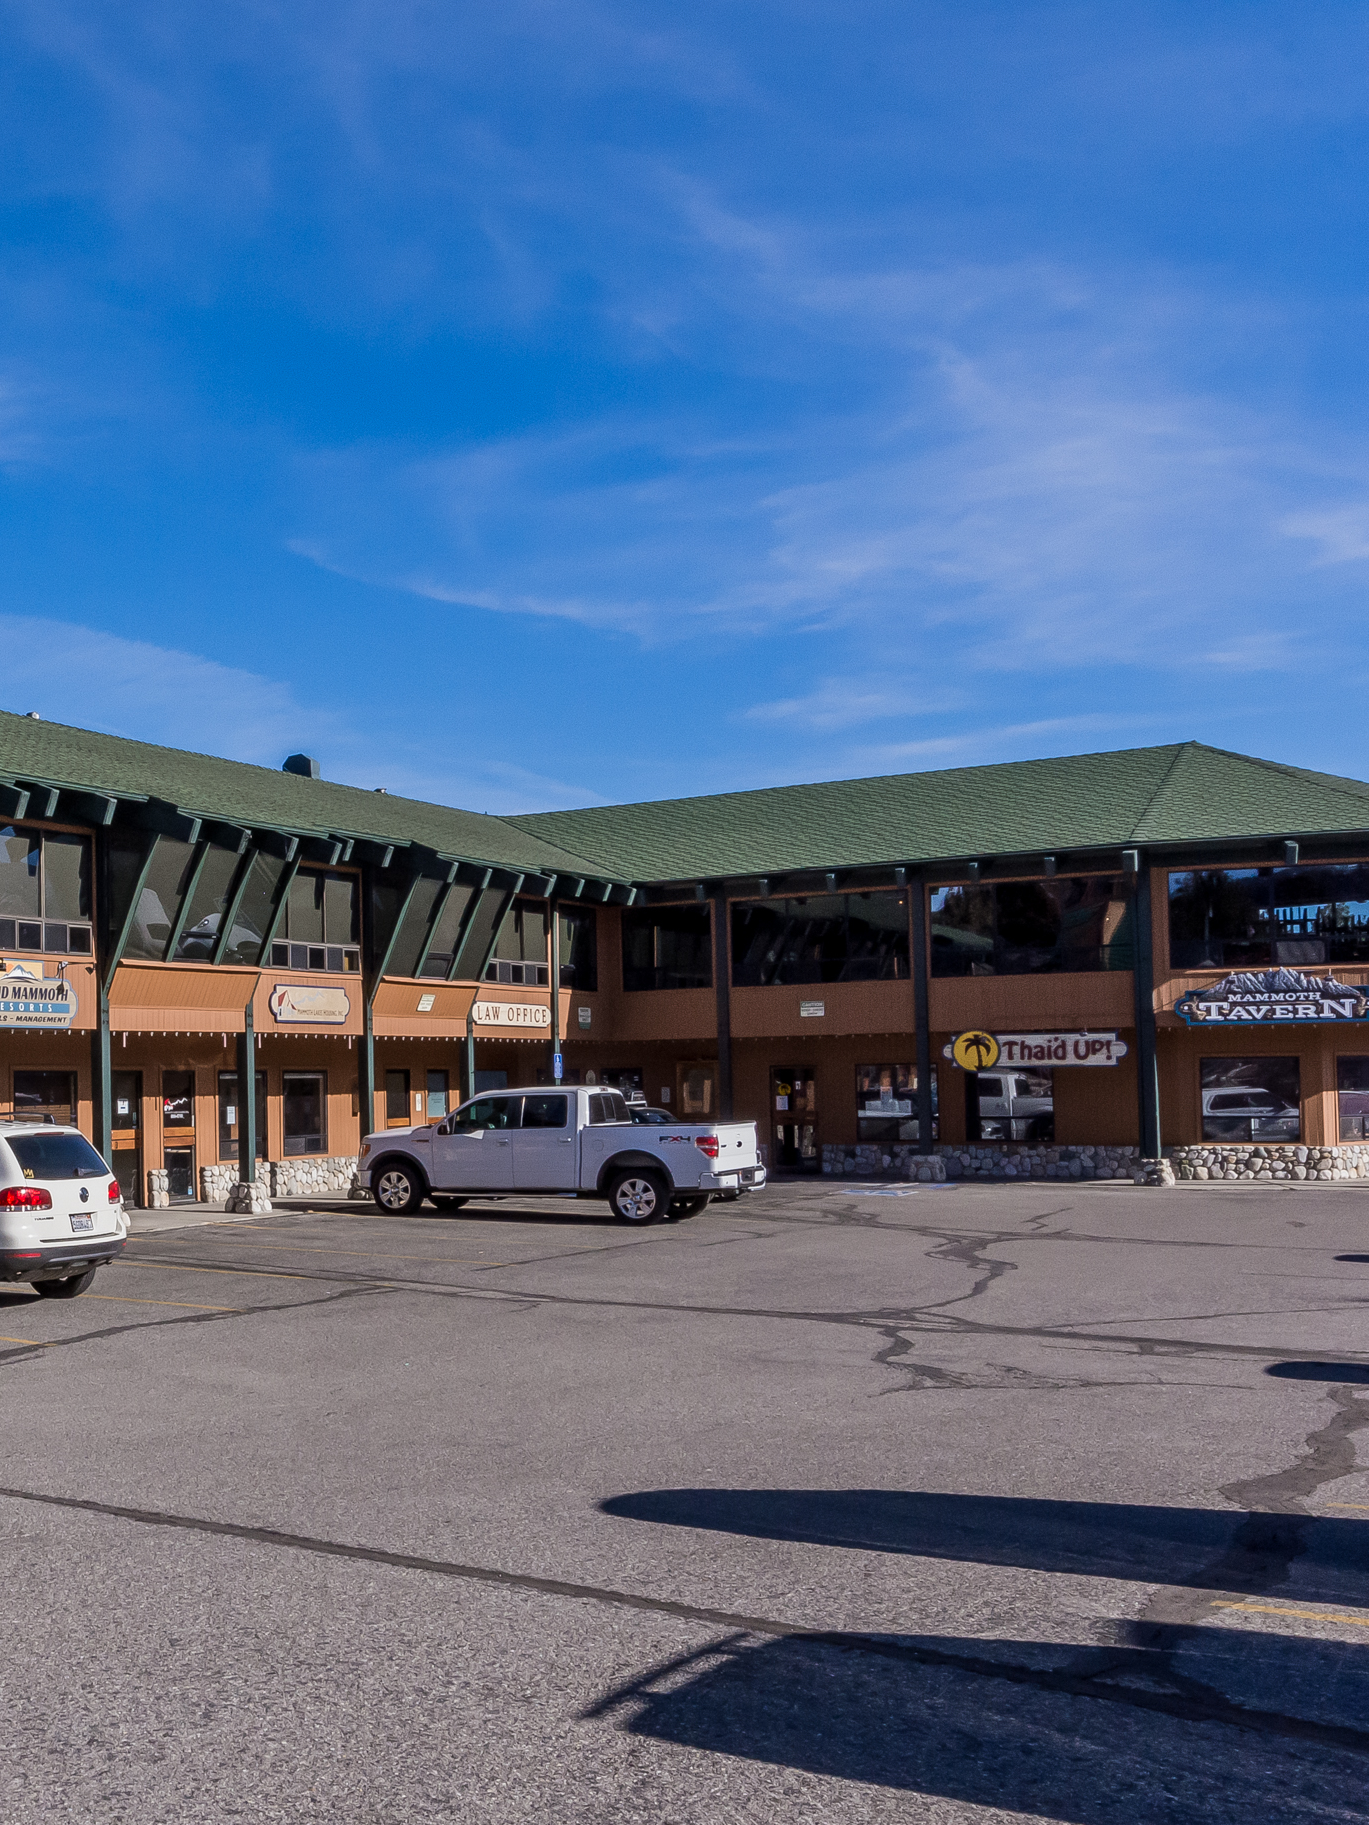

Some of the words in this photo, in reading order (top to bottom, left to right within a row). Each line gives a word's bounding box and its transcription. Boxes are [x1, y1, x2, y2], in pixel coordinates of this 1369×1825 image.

[11, 986, 68, 1001] MAMMOTH
[1227, 992, 1321, 1002] MAMMOTH
[477, 1005, 501, 1020] LAW
[507, 1007, 547, 1023] OFFICE
[1199, 999, 1357, 1021] TAVERN
[15, 1015, 67, 1023] MANAGEMENT
[1002, 1037, 1067, 1060] Thai'd
